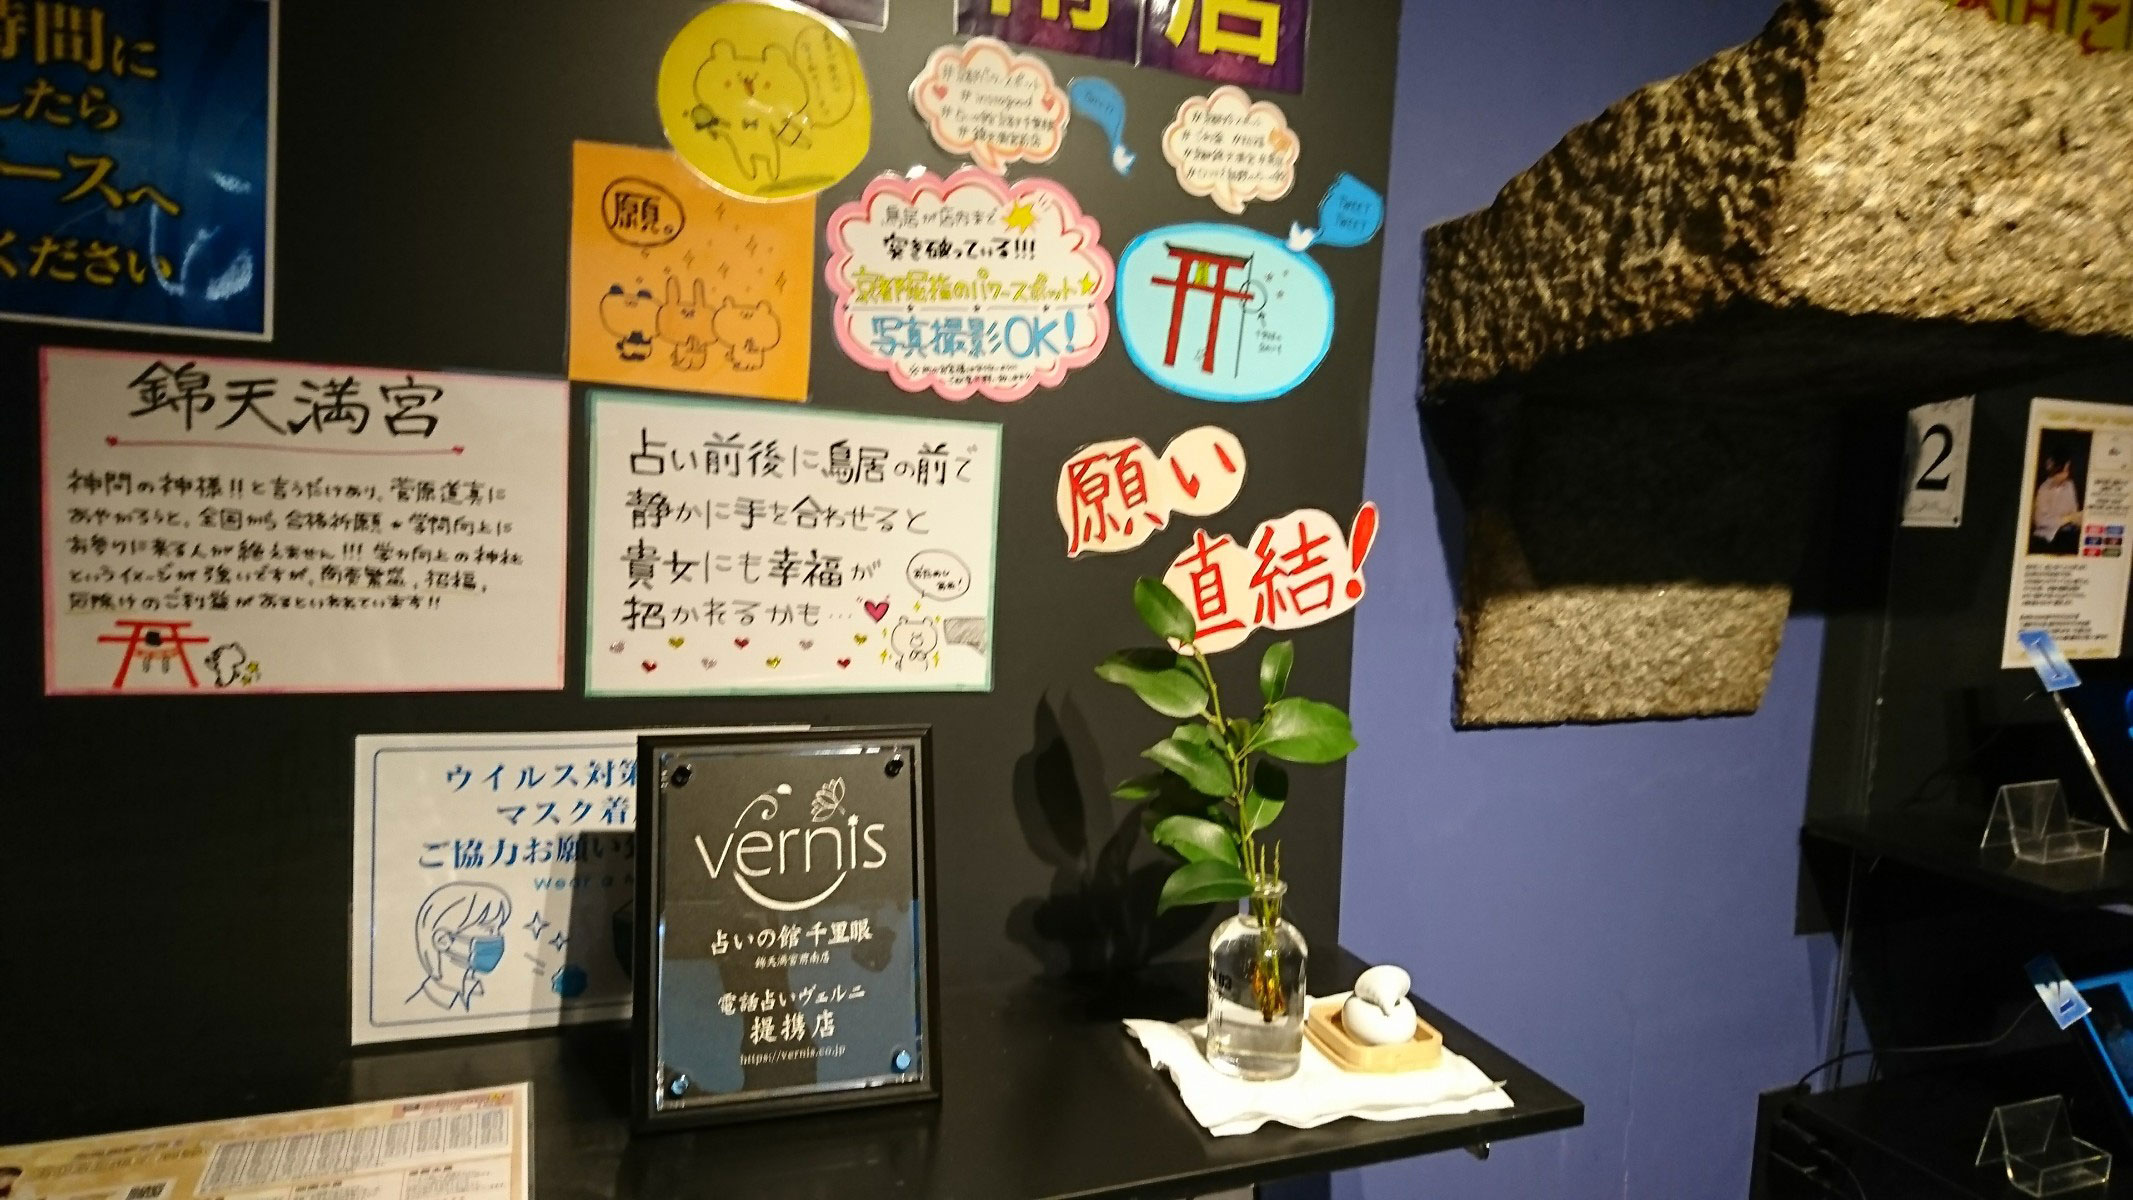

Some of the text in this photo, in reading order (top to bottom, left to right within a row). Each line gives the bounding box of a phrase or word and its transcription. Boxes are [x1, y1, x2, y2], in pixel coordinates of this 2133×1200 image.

[128, 360, 444, 438] 錦天満宮
[629, 426, 978, 485] 占い前後に鳥居の前で
[1916, 424, 1953, 490] 2
[625, 486, 930, 535] 静かに手を合わせると
[1067, 442, 1236, 556] 願い
[620, 538, 882, 590] 貴女にも幸福が
[1174, 506, 1376, 648] 直結!
[497, 795, 637, 825] マスク着
[695, 813, 888, 880] vernis
[710, 917, 874, 956] 占いの館 千里眼
[717, 983, 866, 1016] 電話占いヴェルニ
[749, 1008, 836, 1046] 提携店
